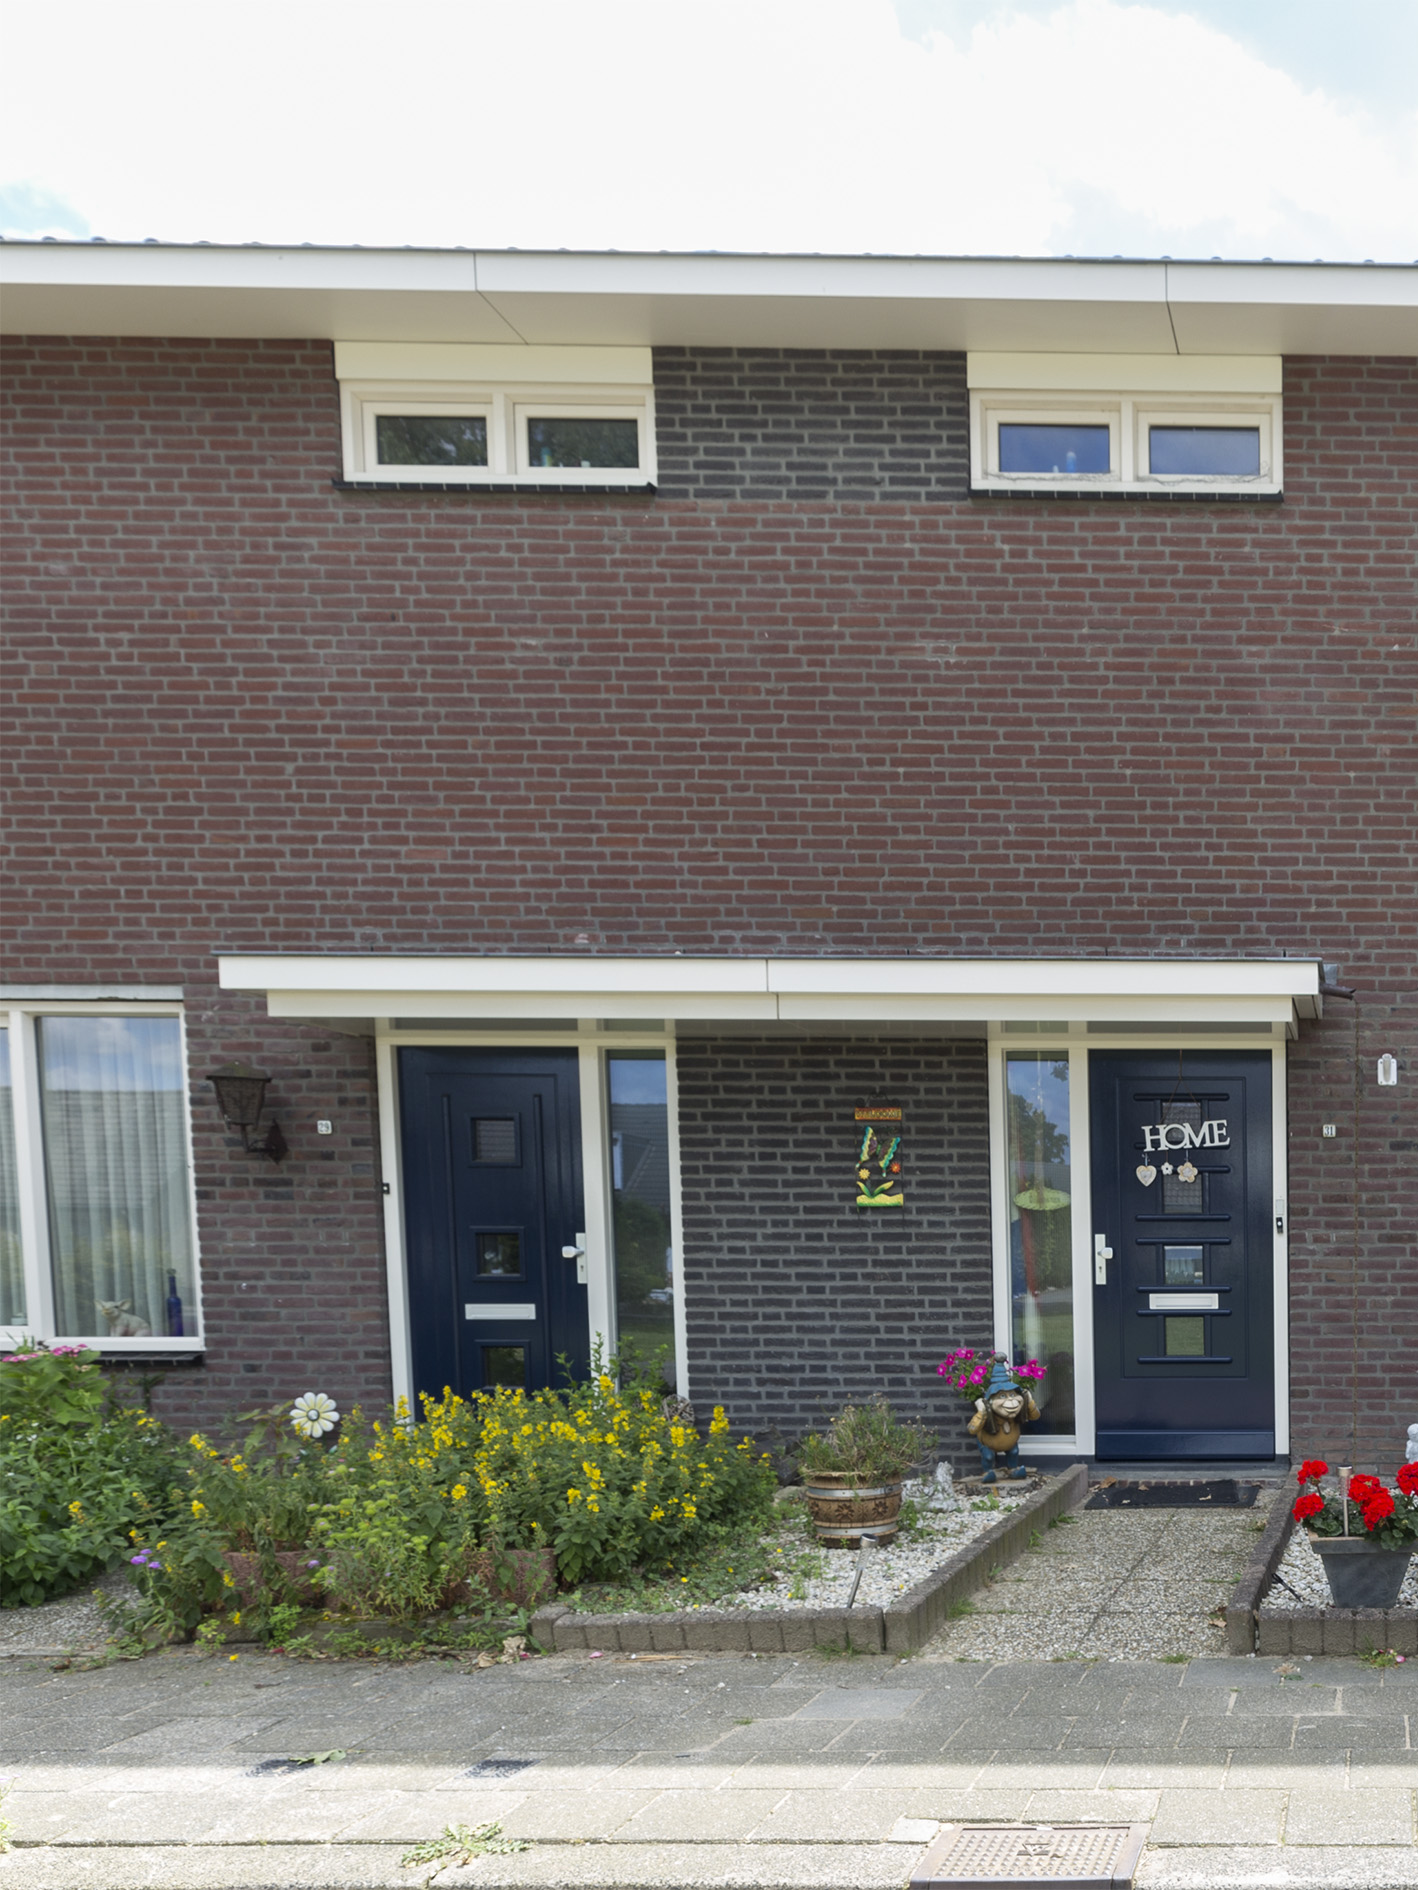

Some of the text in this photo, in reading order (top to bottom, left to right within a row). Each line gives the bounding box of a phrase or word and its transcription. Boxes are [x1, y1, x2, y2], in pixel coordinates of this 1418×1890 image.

[318, 1122, 330, 1133] 29
[1324, 1125, 1333, 1136] 31
[1141, 1119, 1231, 1152] HOME
